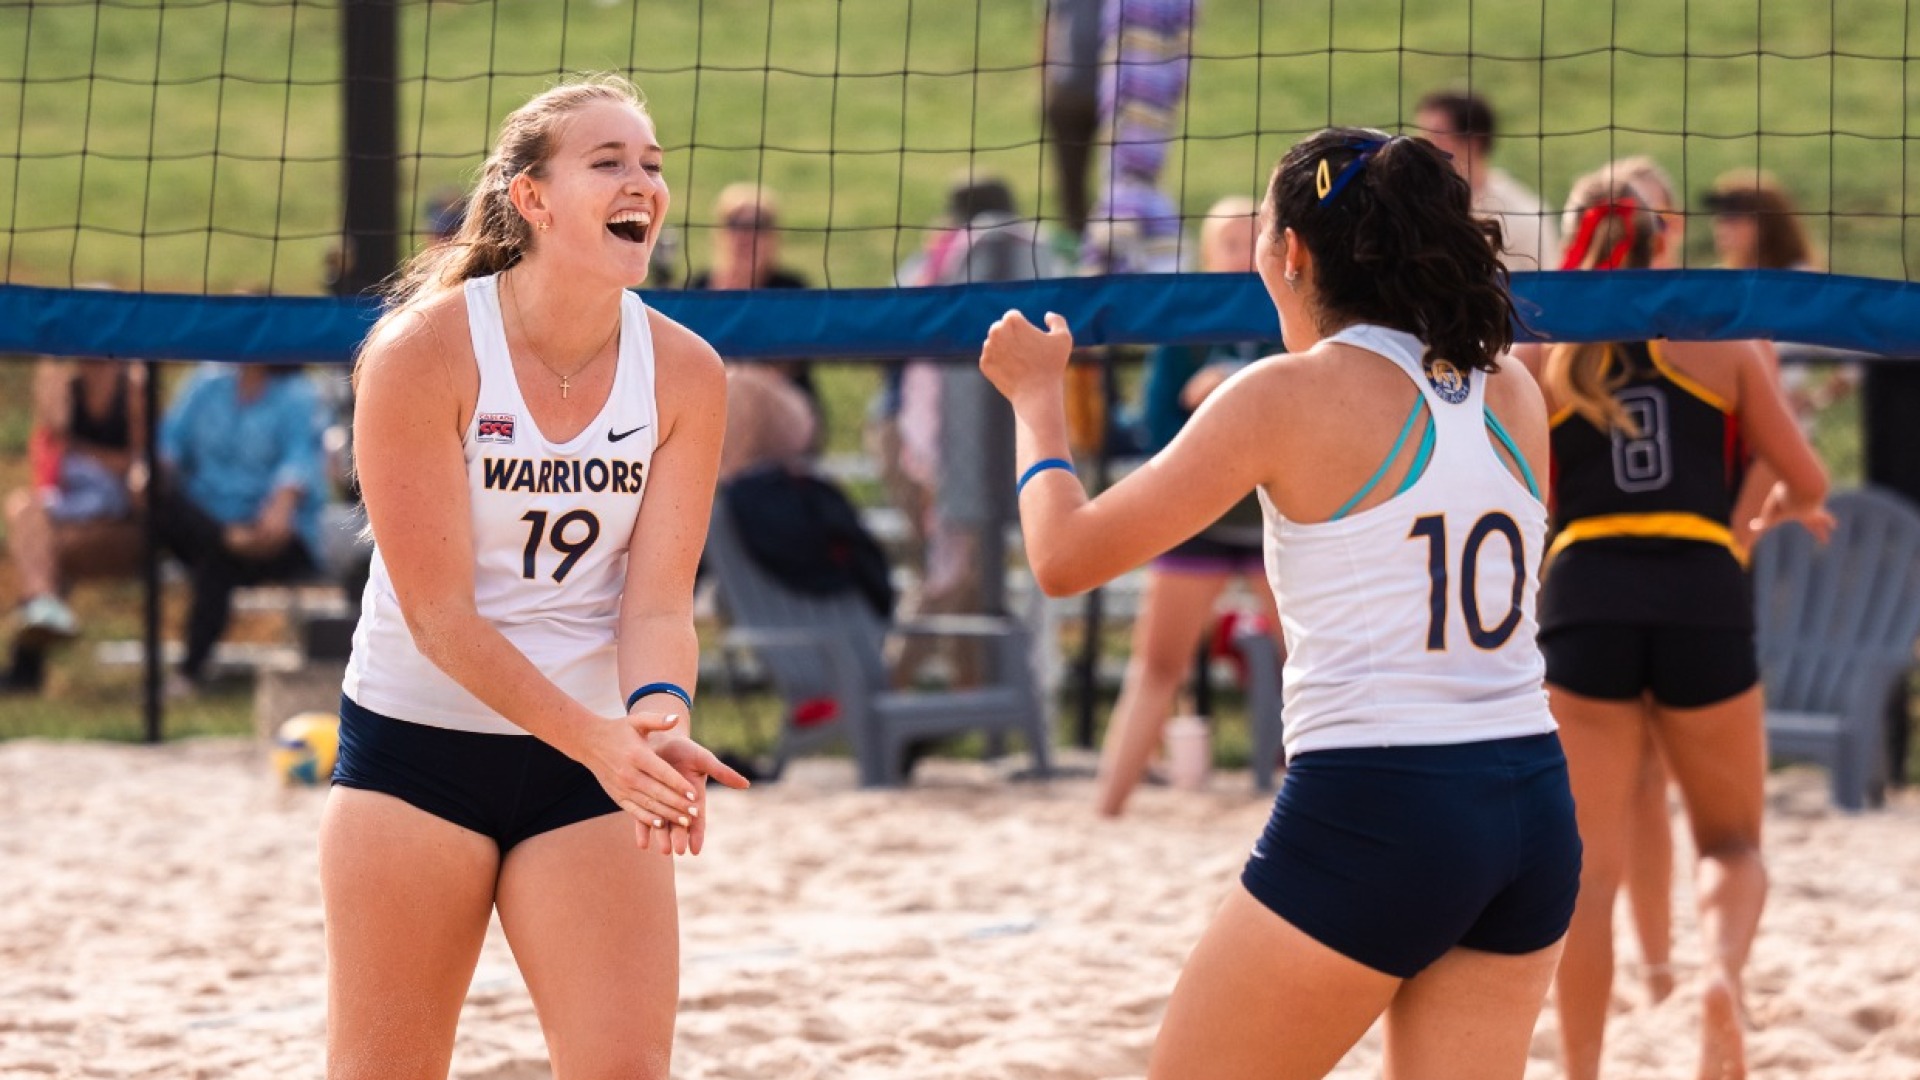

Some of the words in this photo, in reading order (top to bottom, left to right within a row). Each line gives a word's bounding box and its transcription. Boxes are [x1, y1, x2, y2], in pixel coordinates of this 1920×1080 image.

[483, 457, 643, 494] WARRIORS
[1611, 386, 1673, 493] 8
[519, 508, 600, 584] 19
[1407, 509, 1526, 652] 10
